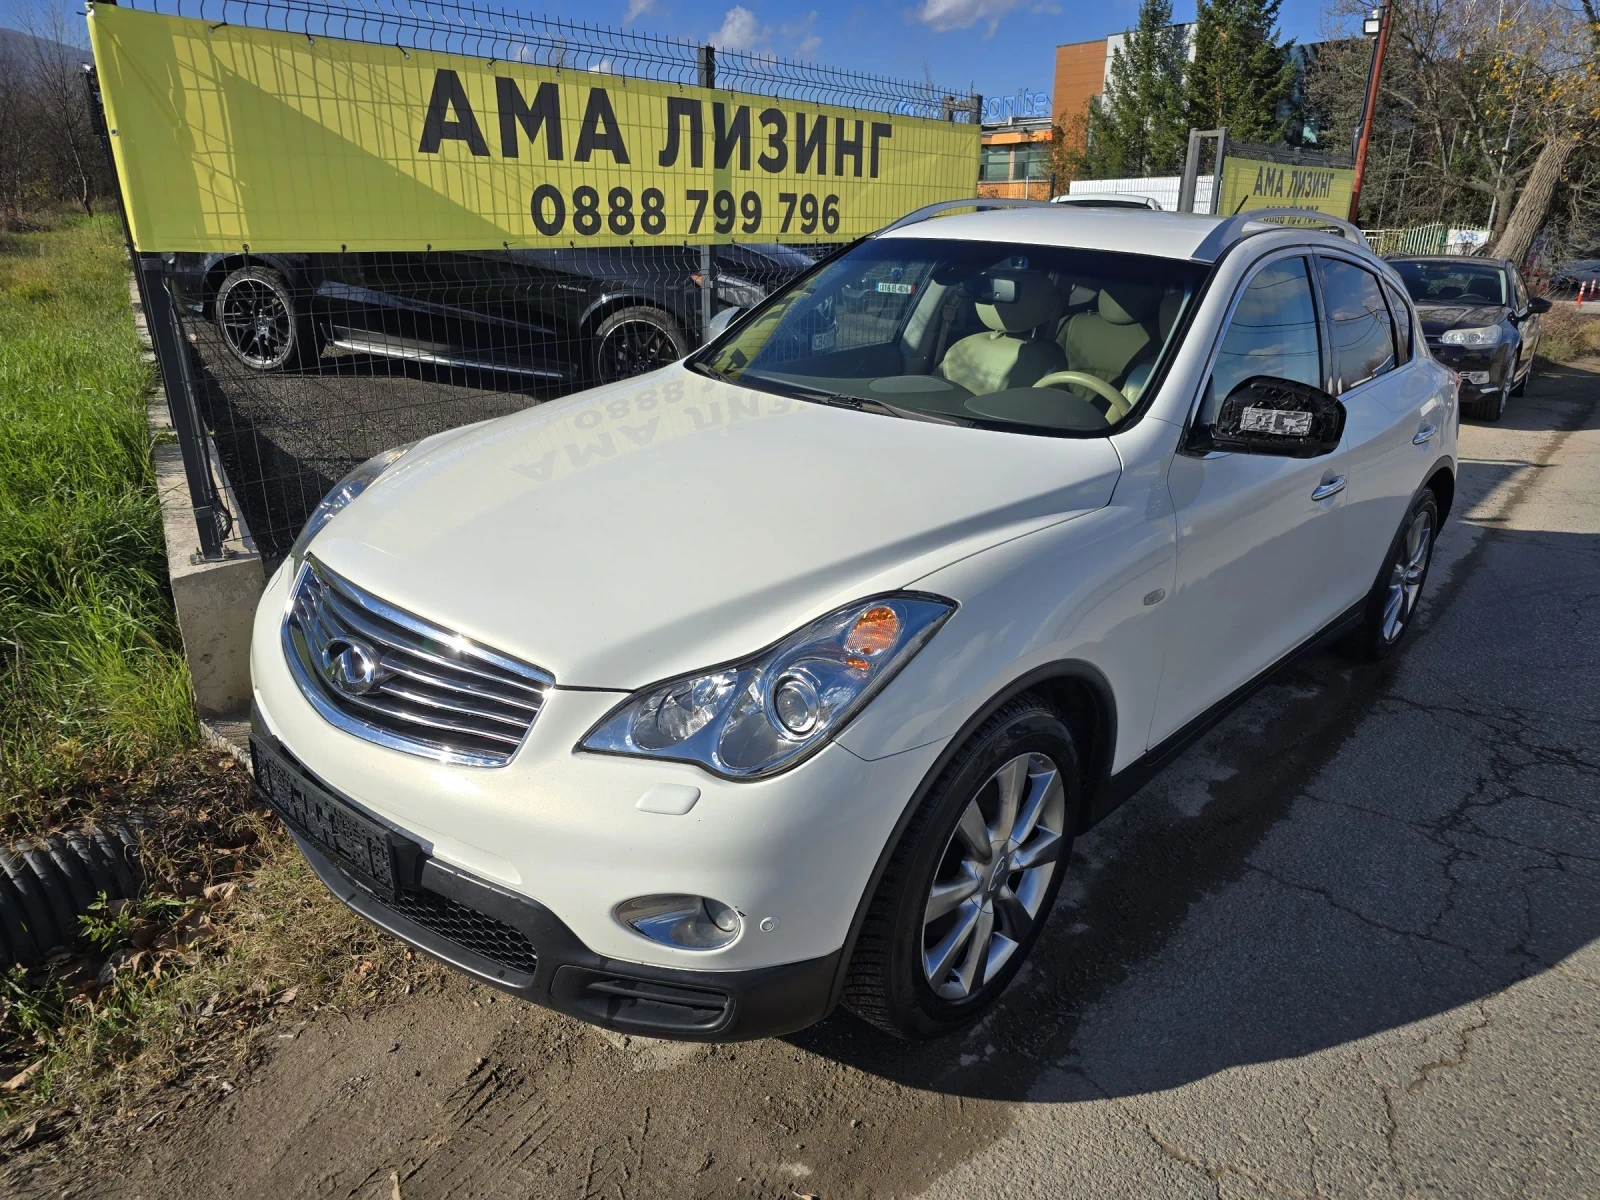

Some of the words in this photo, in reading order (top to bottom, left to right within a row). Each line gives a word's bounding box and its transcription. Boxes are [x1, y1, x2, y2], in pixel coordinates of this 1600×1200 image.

[418, 68, 630, 164] АМА
[658, 96, 892, 179] ЛИЗИНГ
[1253, 166, 1284, 198] АМА
[1286, 170, 1335, 199] ЛИЗИНГ
[530, 183, 667, 237] 0888
[685, 189, 762, 235] 799
[778, 192, 840, 234] 796
